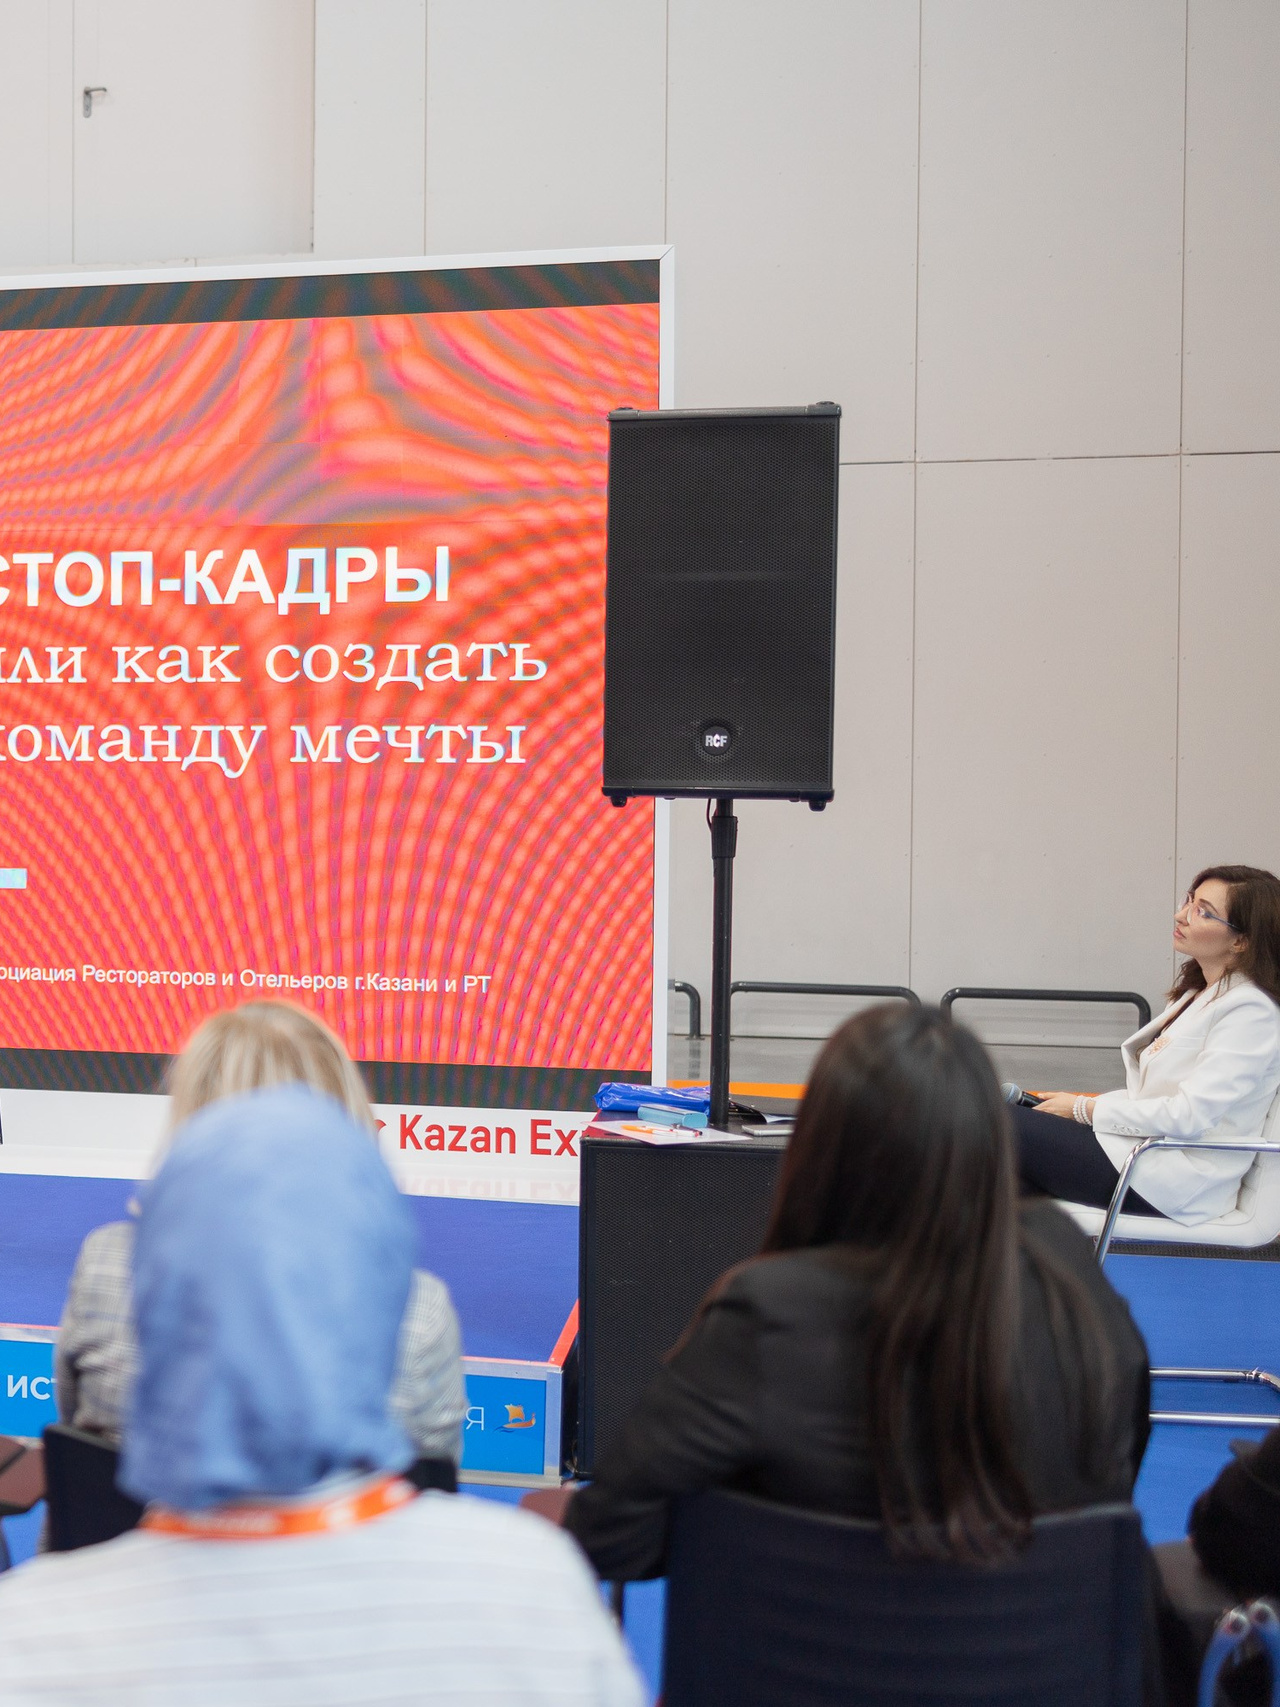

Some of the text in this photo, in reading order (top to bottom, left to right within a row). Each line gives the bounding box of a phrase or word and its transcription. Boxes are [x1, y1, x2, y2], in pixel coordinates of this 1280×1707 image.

[111, 644, 241, 683] как
[265, 641, 548, 692] создать
[290, 724, 527, 764] мечты
[705, 733, 728, 748] RCF
[82, 964, 217, 988] Рестораторов
[221, 973, 234, 986] и
[240, 968, 348, 992] Отельеров
[354, 972, 437, 992] г.Казани
[445, 978, 457, 992] и
[464, 975, 492, 993] РТ
[399, 1113, 580, 1157] Kazan Ex
